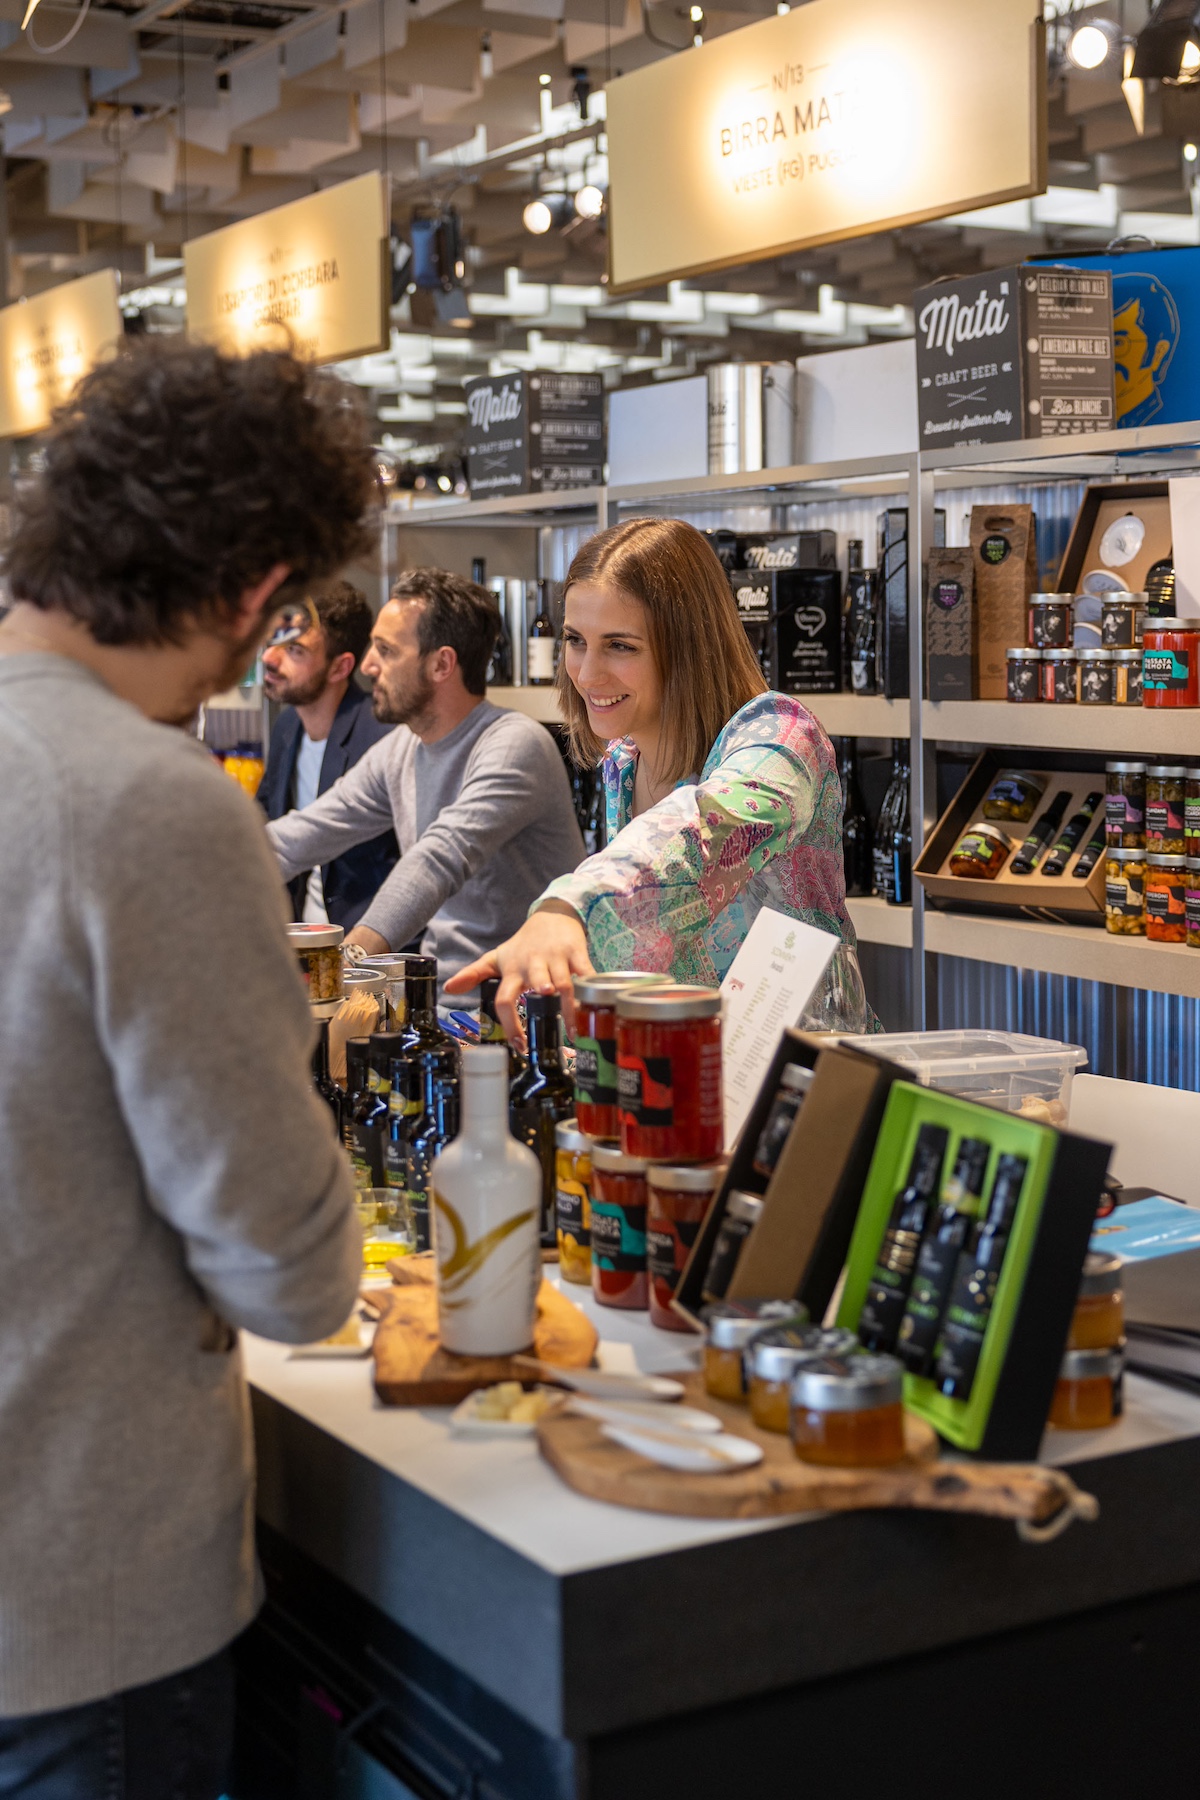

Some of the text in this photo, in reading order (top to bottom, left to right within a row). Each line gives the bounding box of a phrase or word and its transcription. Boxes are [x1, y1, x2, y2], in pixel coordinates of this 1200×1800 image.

[721, 111, 787, 157] BIRRA
[1043, 338, 1107, 355] AMERICAN PALE ALE
[935, 362, 999, 387] CRAFT BEER
[1050, 398, 1102, 415] Bio BLANCHE
